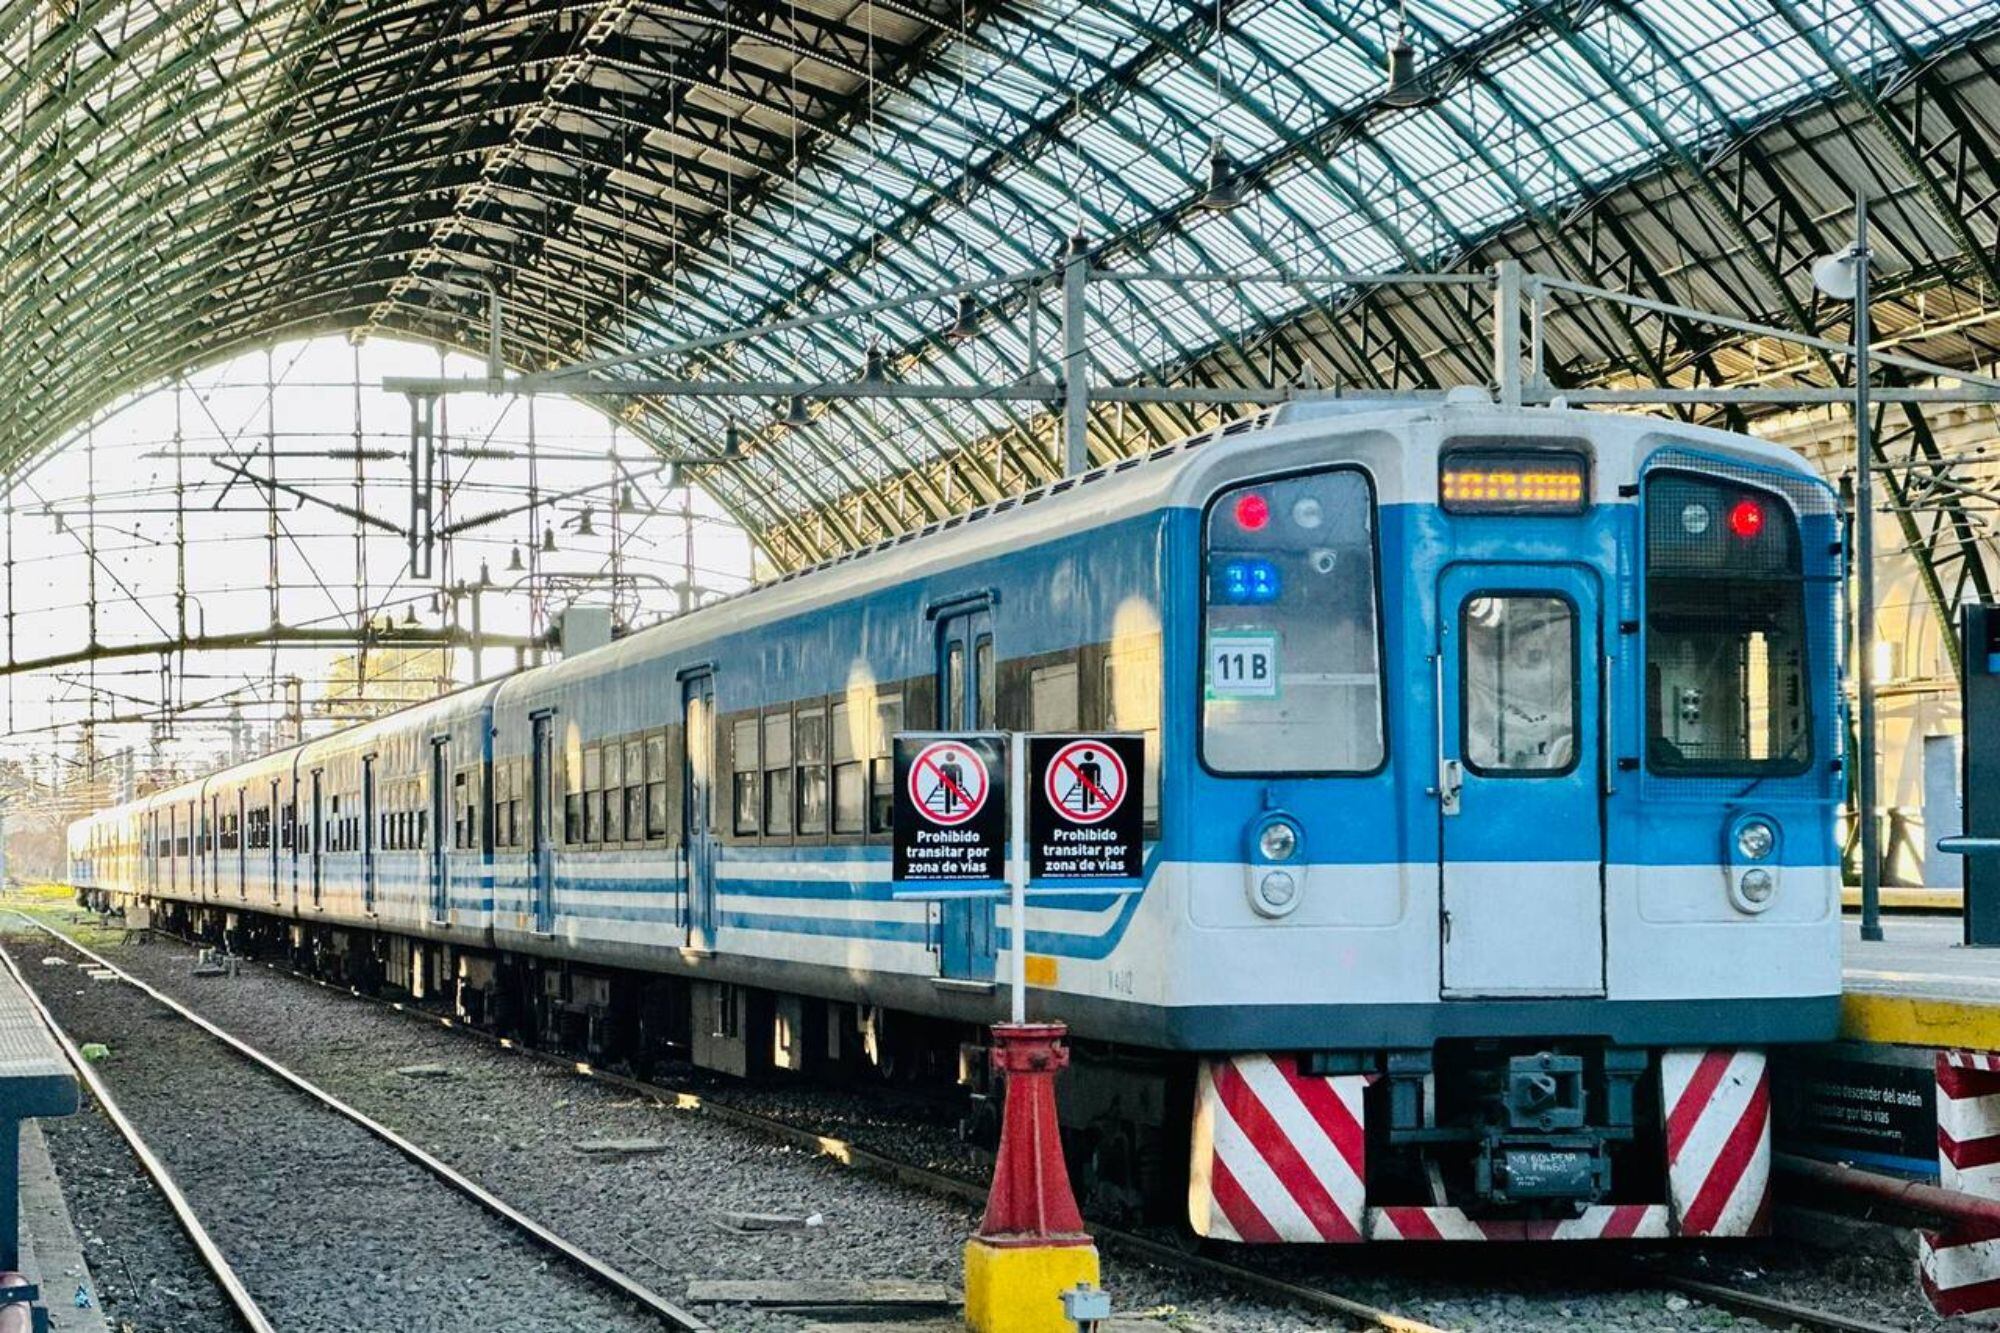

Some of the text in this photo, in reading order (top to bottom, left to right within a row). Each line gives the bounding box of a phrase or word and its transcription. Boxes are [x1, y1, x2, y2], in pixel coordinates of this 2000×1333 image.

[916, 830, 981, 843] Prohibido
[1053, 828, 1118, 841] Prohibido
[906, 845, 990, 860] transitar por
[1043, 844, 1128, 858] transitar por
[908, 861, 939, 873] zona
[941, 860, 959, 873] de
[1045, 860, 1077, 871] zona
[1079, 859, 1096, 871] de
[1882, 1087, 1896, 1104] del
[1896, 1089, 1923, 1107] andén
[1860, 1105, 1873, 1122] las
